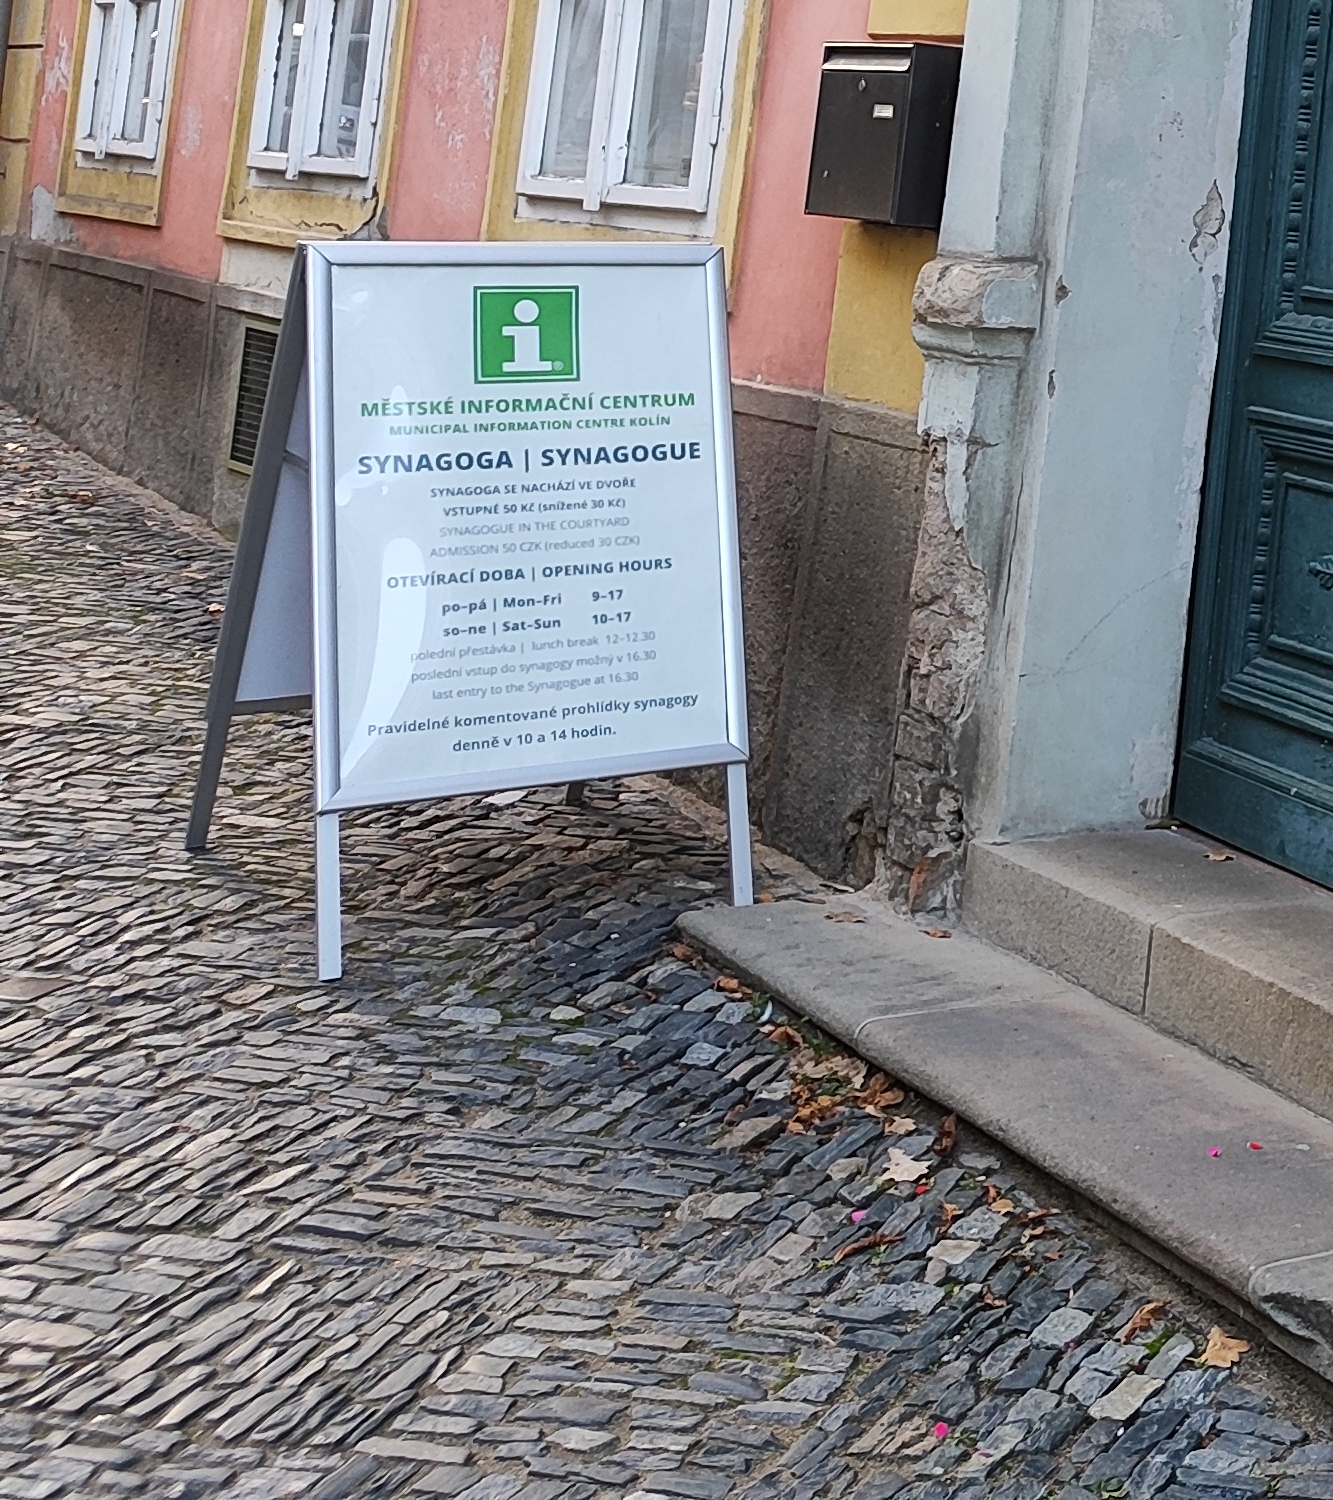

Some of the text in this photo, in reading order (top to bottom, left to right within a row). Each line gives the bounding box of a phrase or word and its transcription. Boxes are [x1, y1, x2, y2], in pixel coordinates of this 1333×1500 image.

[361, 392, 694, 417] MĚSTSKÉ INFORMAČNÍ CENTRUM
[390, 414, 670, 436] MUNICIPAL INFORMATION CENTRE KOLÍN
[358, 442, 700, 474] SYNAGOGA SYNAGOGUE
[431, 477, 635, 497] SYNAGOGA SE NACHÁZÍ VE DVOŘE
[443, 498, 625, 517] VSTUPNÉ 50 Kč (snížené 30 Kč)
[440, 516, 630, 537] SYNAGOGUE IN THE COURTYARD
[430, 535, 640, 558] ADMISSION 50 CZK (reduced 30 CZK)
[387, 558, 672, 589] OTEVÍRACÍ DOBA OPENING HOURS
[411, 647, 455, 664] polední
[459, 642, 517, 660] přestávka
[532, 638, 563, 651] lunch
[567, 636, 599, 648] break
[411, 649, 656, 684] poslední vstup do synagogy možný v 16.30
[433, 671, 638, 700] last entry to the Synagogue at 16.30
[368, 694, 698, 736] Pravidelné komentované prohlídky synagogy
[453, 724, 616, 752] denně v 10 a 14 hodin.
